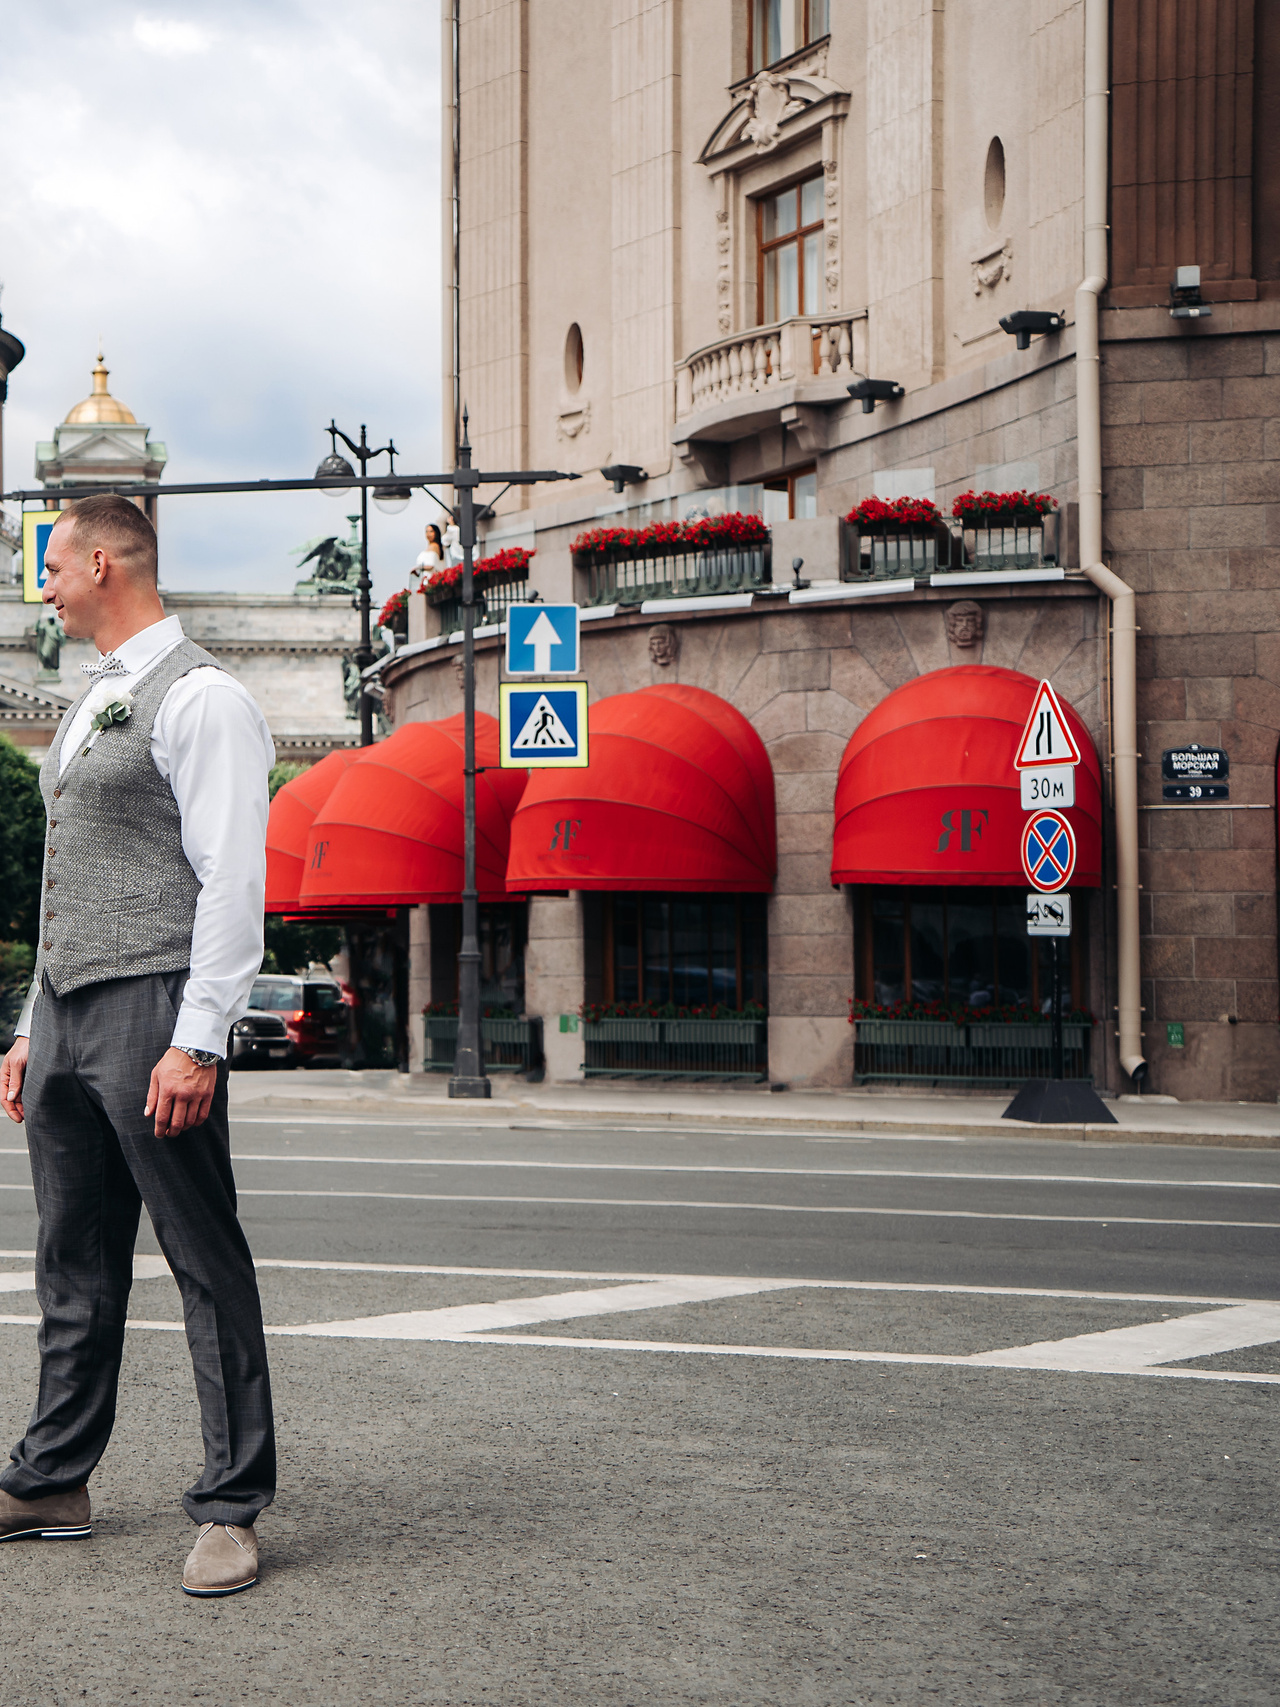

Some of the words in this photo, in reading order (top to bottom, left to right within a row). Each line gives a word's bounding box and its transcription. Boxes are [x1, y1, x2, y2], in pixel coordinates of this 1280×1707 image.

[1171, 752, 1220, 762] БОЛЬШАЯ
[1173, 761, 1219, 770] МОРСКАЯ
[1189, 785, 1202, 798] 39
